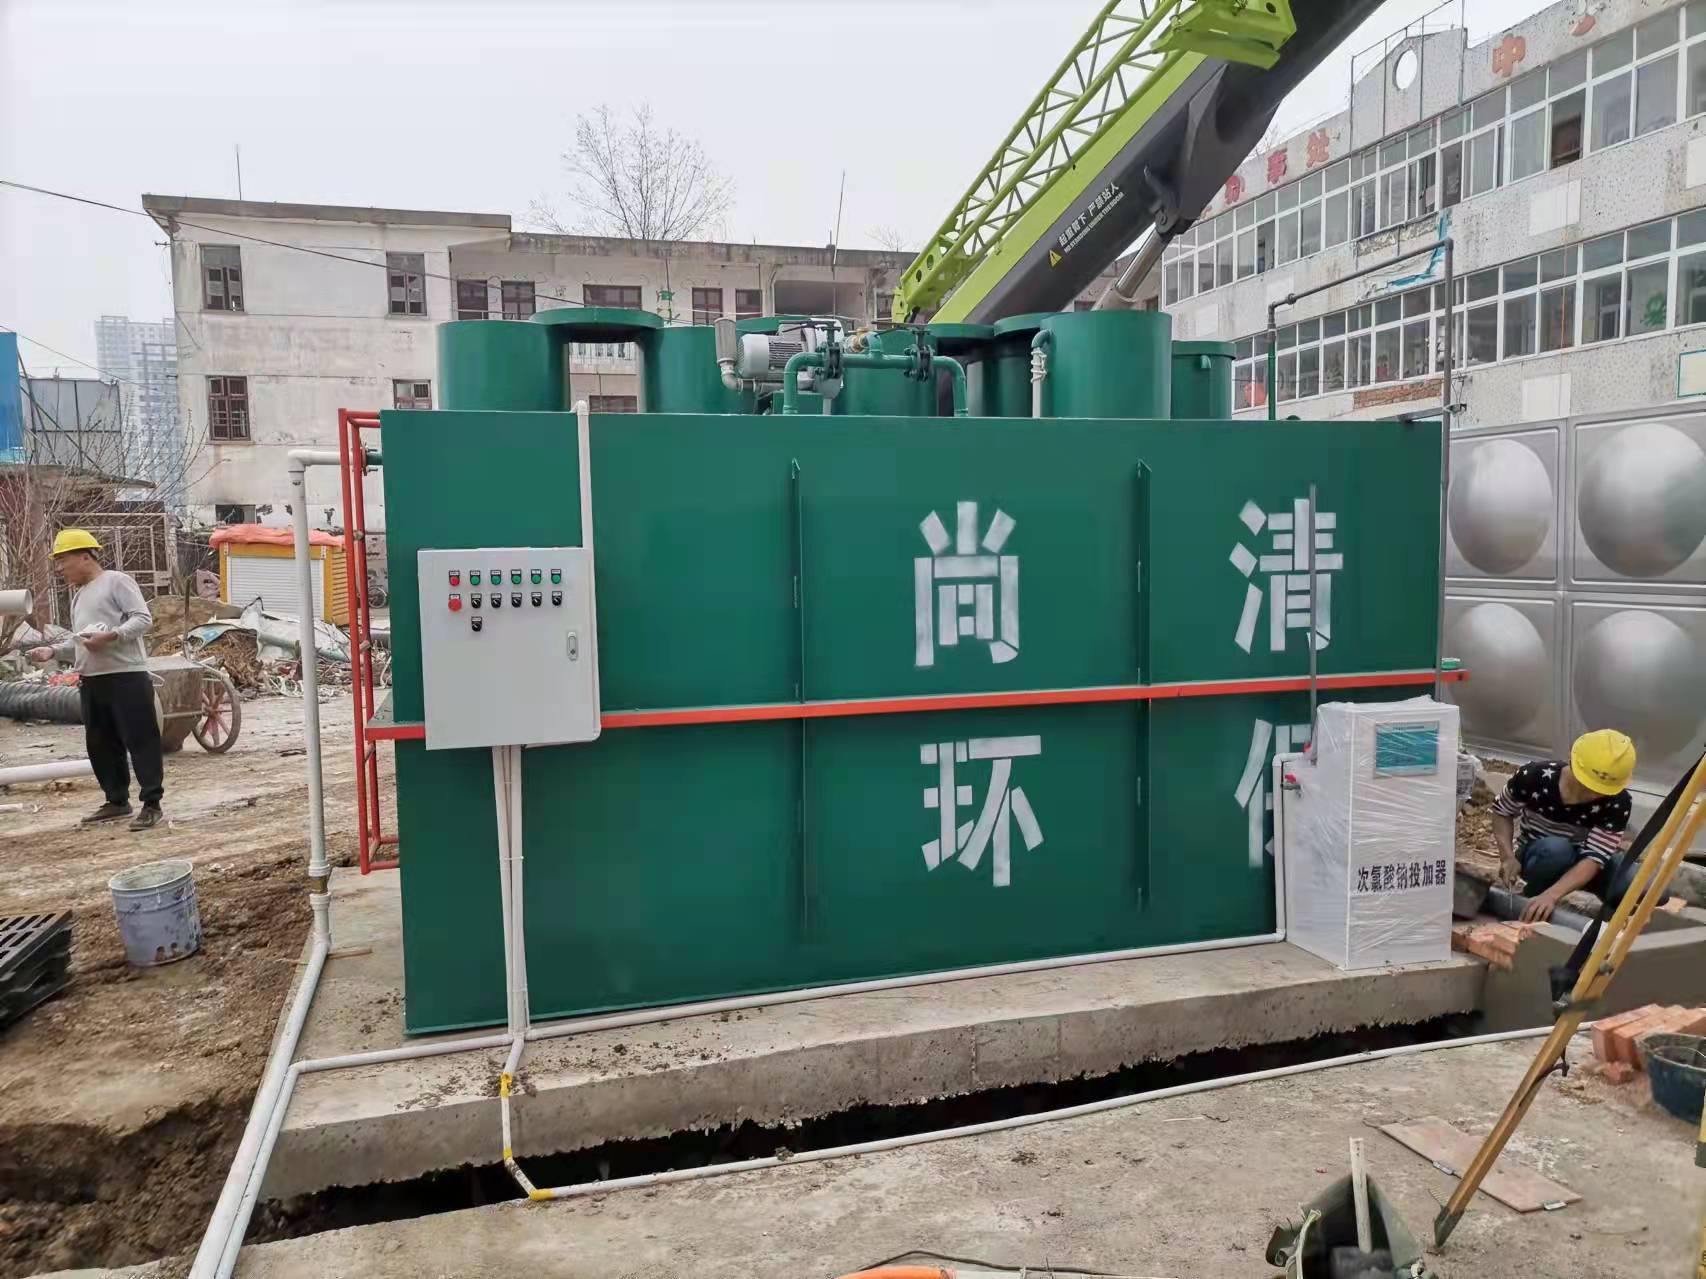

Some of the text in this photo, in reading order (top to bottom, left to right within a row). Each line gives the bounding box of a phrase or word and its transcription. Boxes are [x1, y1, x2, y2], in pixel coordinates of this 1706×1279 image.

[1088, 182, 1119, 217] 严禁站人
[920, 735, 1045, 887] 环
[1357, 859, 1447, 893] 次氯酸钠投加器
